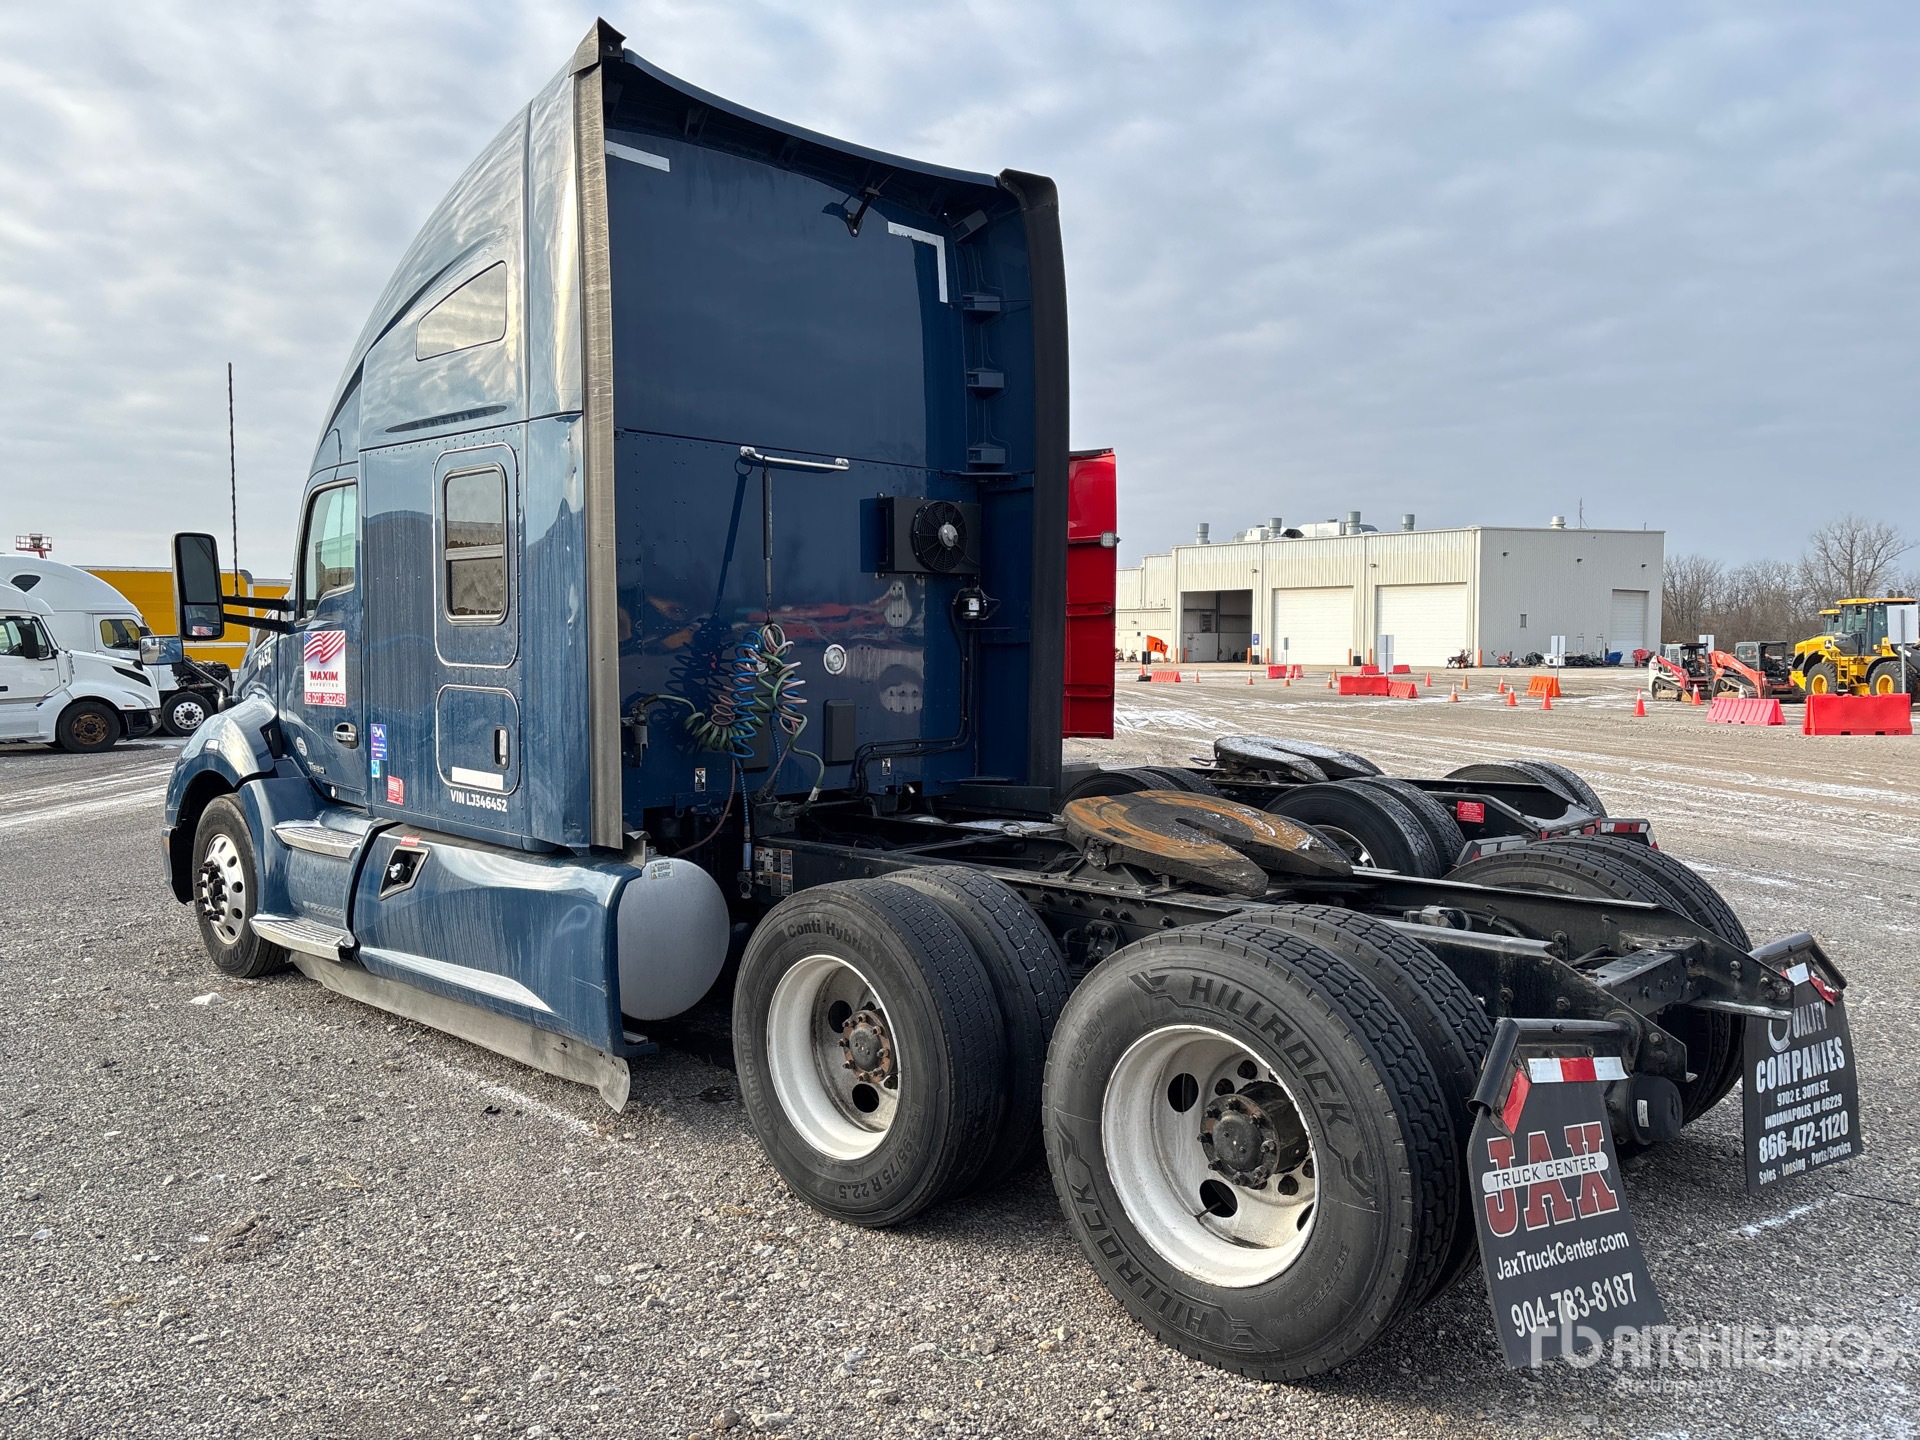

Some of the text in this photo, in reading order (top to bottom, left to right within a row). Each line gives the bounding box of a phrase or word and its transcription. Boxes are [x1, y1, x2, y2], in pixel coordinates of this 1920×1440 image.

[258, 647, 272, 671] 6452
[310, 671, 338, 681] MAXIM
[312, 693, 321, 703] DOT
[450, 789, 508, 813] VIN LJ346452
[787, 919, 822, 938] Conti
[1188, 975, 1352, 1127] HILLROCK
[1756, 1036, 1846, 1094] COMPANIES
[1765, 1093, 1843, 1130] INDIANAPOLIS, IN 46229
[1777, 1090, 1795, 1107] 9702
[1802, 1082, 1820, 1100] 30TH
[1759, 1110, 1849, 1164] 866-472-1120
[1484, 1120, 1620, 1237] JAX
[1493, 1156, 1597, 1188] TRUCK CENTER
[1759, 1141, 1852, 1186] Sales Leasing Parts/Service
[838, 1182, 870, 1200] 22.5
[871, 1176, 883, 1193] R
[1071, 1183, 1211, 1337] HILLROCK
[1497, 1231, 1630, 1280] JaxTruckCenter.com
[1511, 1272, 1637, 1338] 904-783-8187
